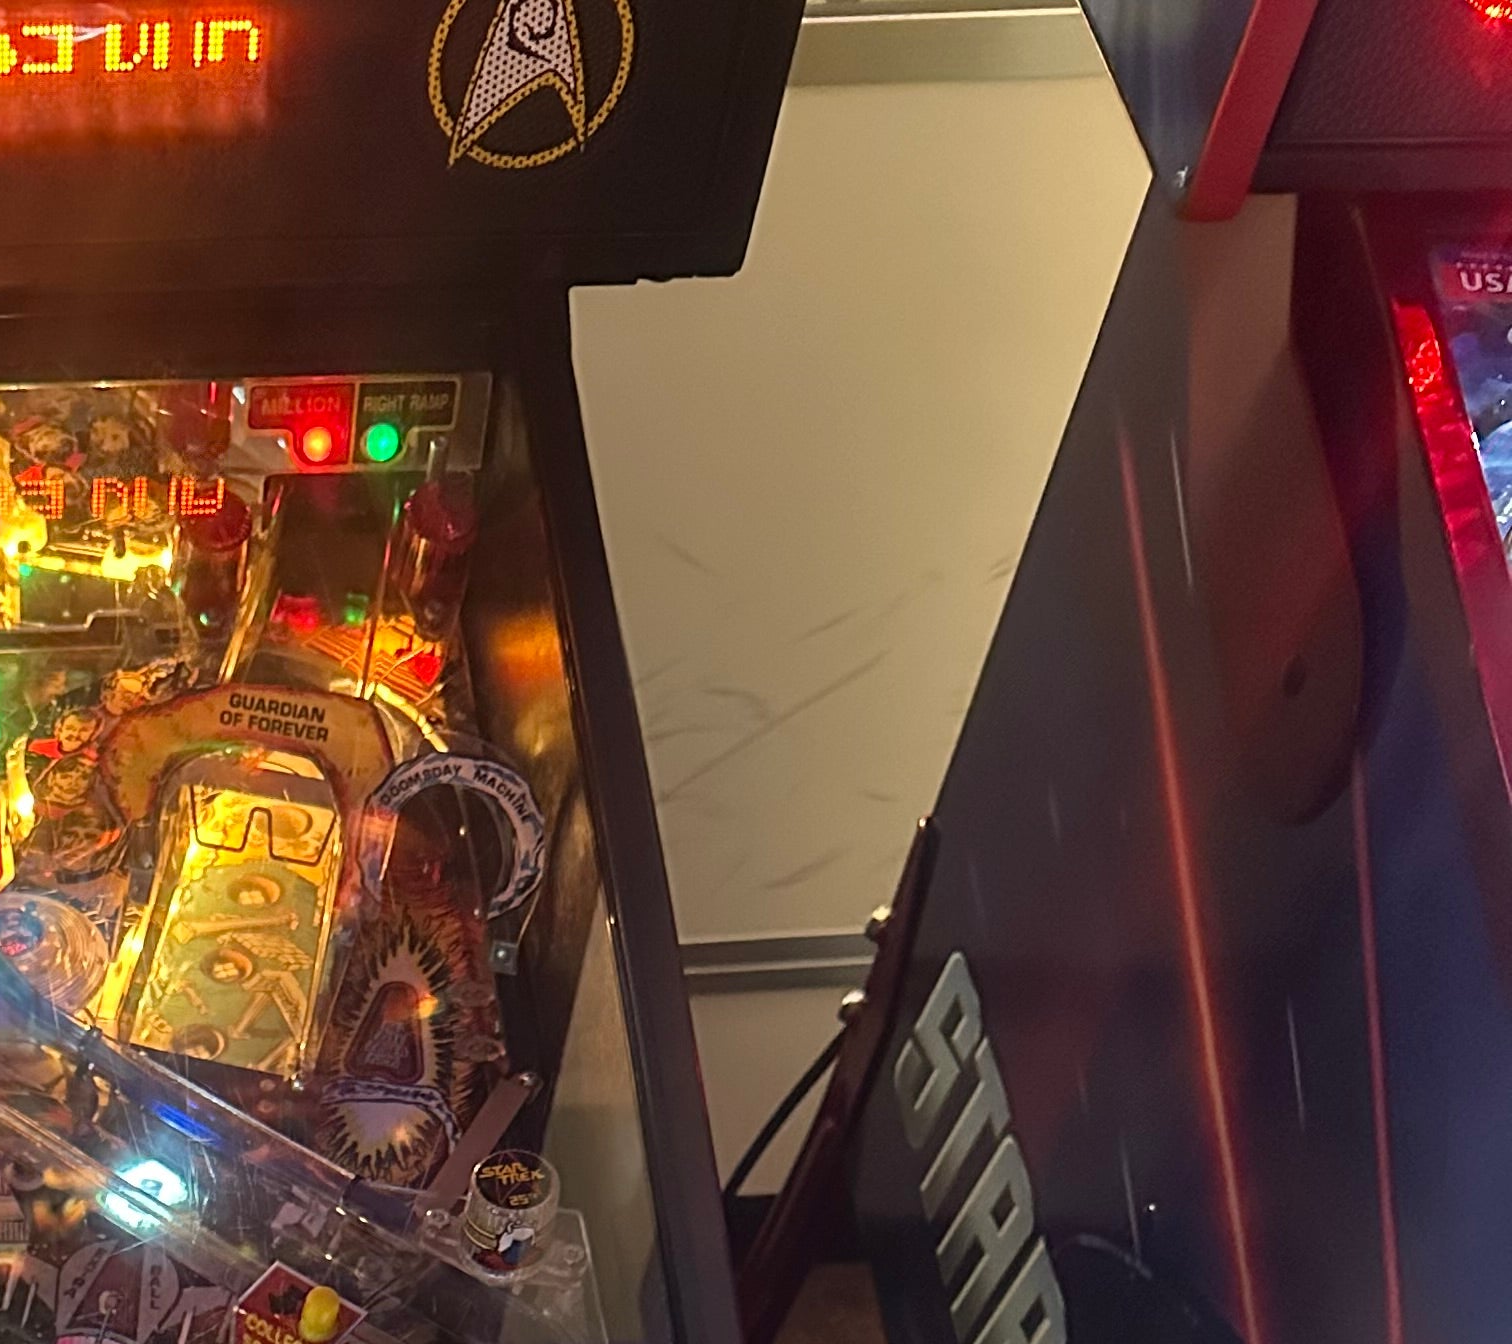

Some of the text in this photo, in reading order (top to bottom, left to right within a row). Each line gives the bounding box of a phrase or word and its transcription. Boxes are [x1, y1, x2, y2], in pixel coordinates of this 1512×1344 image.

[363, 395, 406, 412] RIGHT
[229, 692, 326, 723] GUARDIAN
[219, 710, 329, 742] OF FOREVER
[479, 1162, 527, 1179] STAR
[498, 1169, 545, 1185] TREK
